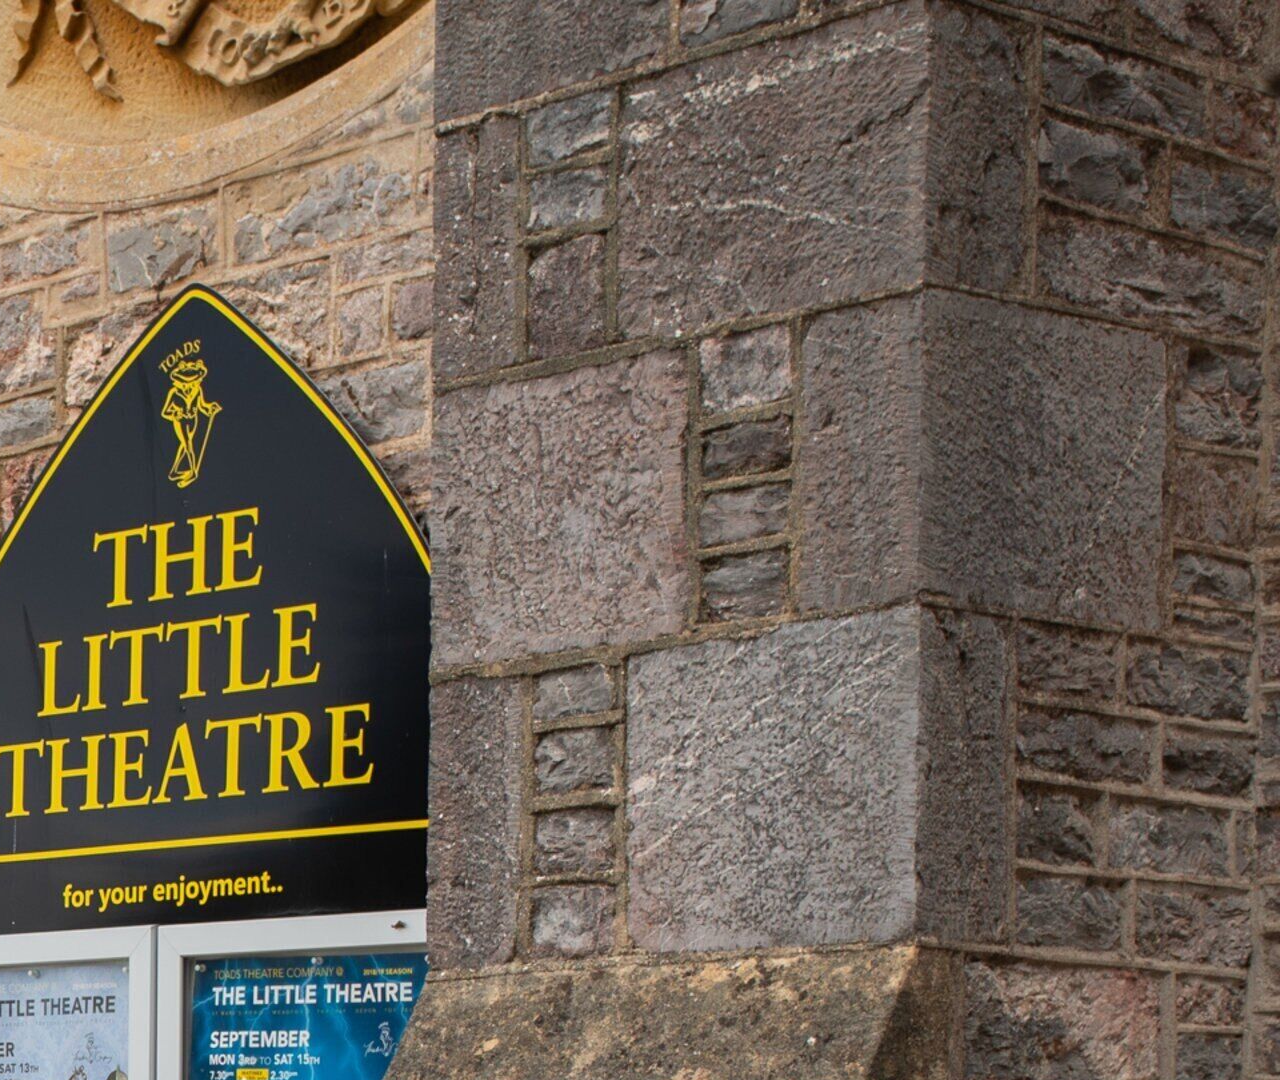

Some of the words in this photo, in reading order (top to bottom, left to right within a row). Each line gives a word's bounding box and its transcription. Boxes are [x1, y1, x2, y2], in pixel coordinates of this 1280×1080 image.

[158, 339, 201, 373] TOADS
[93, 507, 263, 609] THE
[37, 603, 321, 718] LITTLE
[63, 884, 94, 908] for
[99, 885, 147, 912] your
[152, 871, 283, 907] enjoyment..
[214, 970, 241, 980] TOADS
[243, 969, 284, 979] THEATRE
[287, 966, 334, 977] COMPANY
[386, 967, 413, 975] SEASON
[212, 986, 246, 1006] THE
[252, 984, 317, 1005] LITTLE
[323, 982, 413, 1004] THEATRE
[41, 995, 116, 1016] THEATRE
[209, 1030, 310, 1050] SEPTEMBER
[0, 1063, 16, 1074] SAT
[19, 1062, 39, 1074] 13TH
[209, 1054, 235, 1065] MON
[238, 1054, 257, 1066] 3RD
[260, 1055, 271, 1065] TO
[274, 1054, 294, 1065] SAT
[297, 1054, 320, 1065] 15TH
